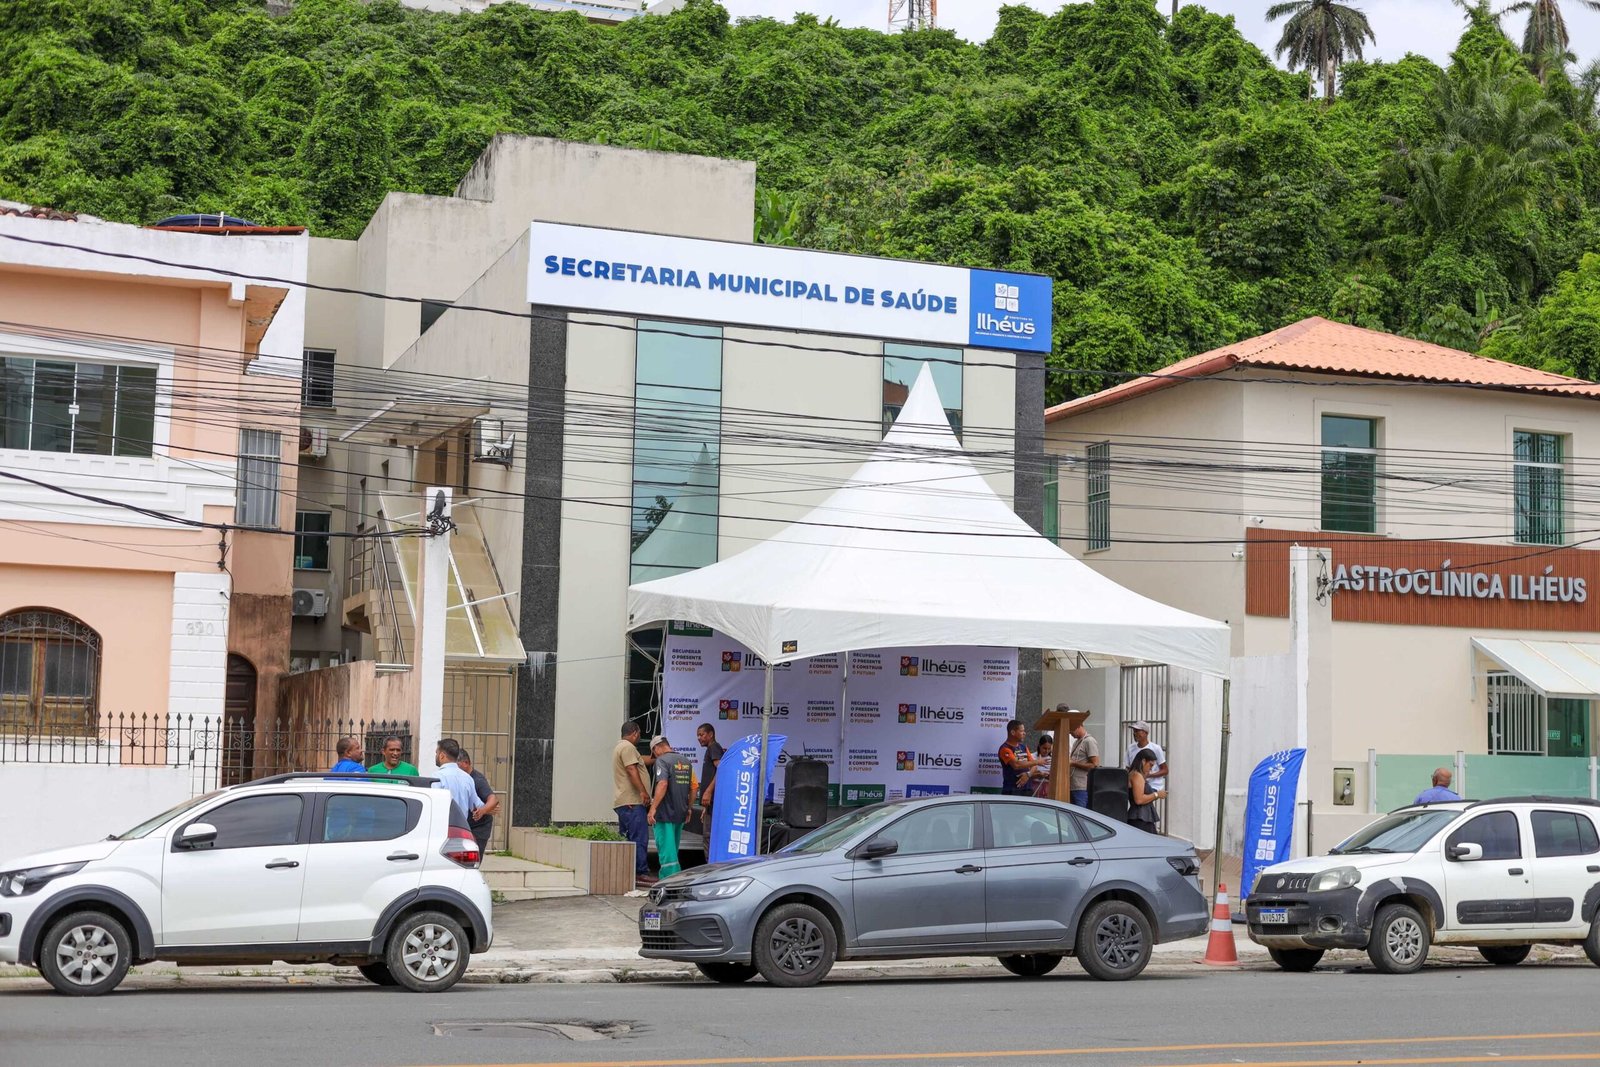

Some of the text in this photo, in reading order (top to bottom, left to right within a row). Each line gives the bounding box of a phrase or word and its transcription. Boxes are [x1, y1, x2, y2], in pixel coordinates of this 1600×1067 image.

[544, 255, 957, 314] SECRETARIA MUNICIPAL DE SAÚDE
[978, 312, 1036, 334] Ilhéus
[1333, 560, 1587, 602] ASTROCLÍNICA ILHÉUS
[922, 659, 966, 674] Ilhéus
[920, 706, 964, 720] Ilhéus
[918, 753, 962, 767] Ilhéus
[733, 771, 750, 827] Ilhéus
[1261, 785, 1277, 835] Ilhéus
